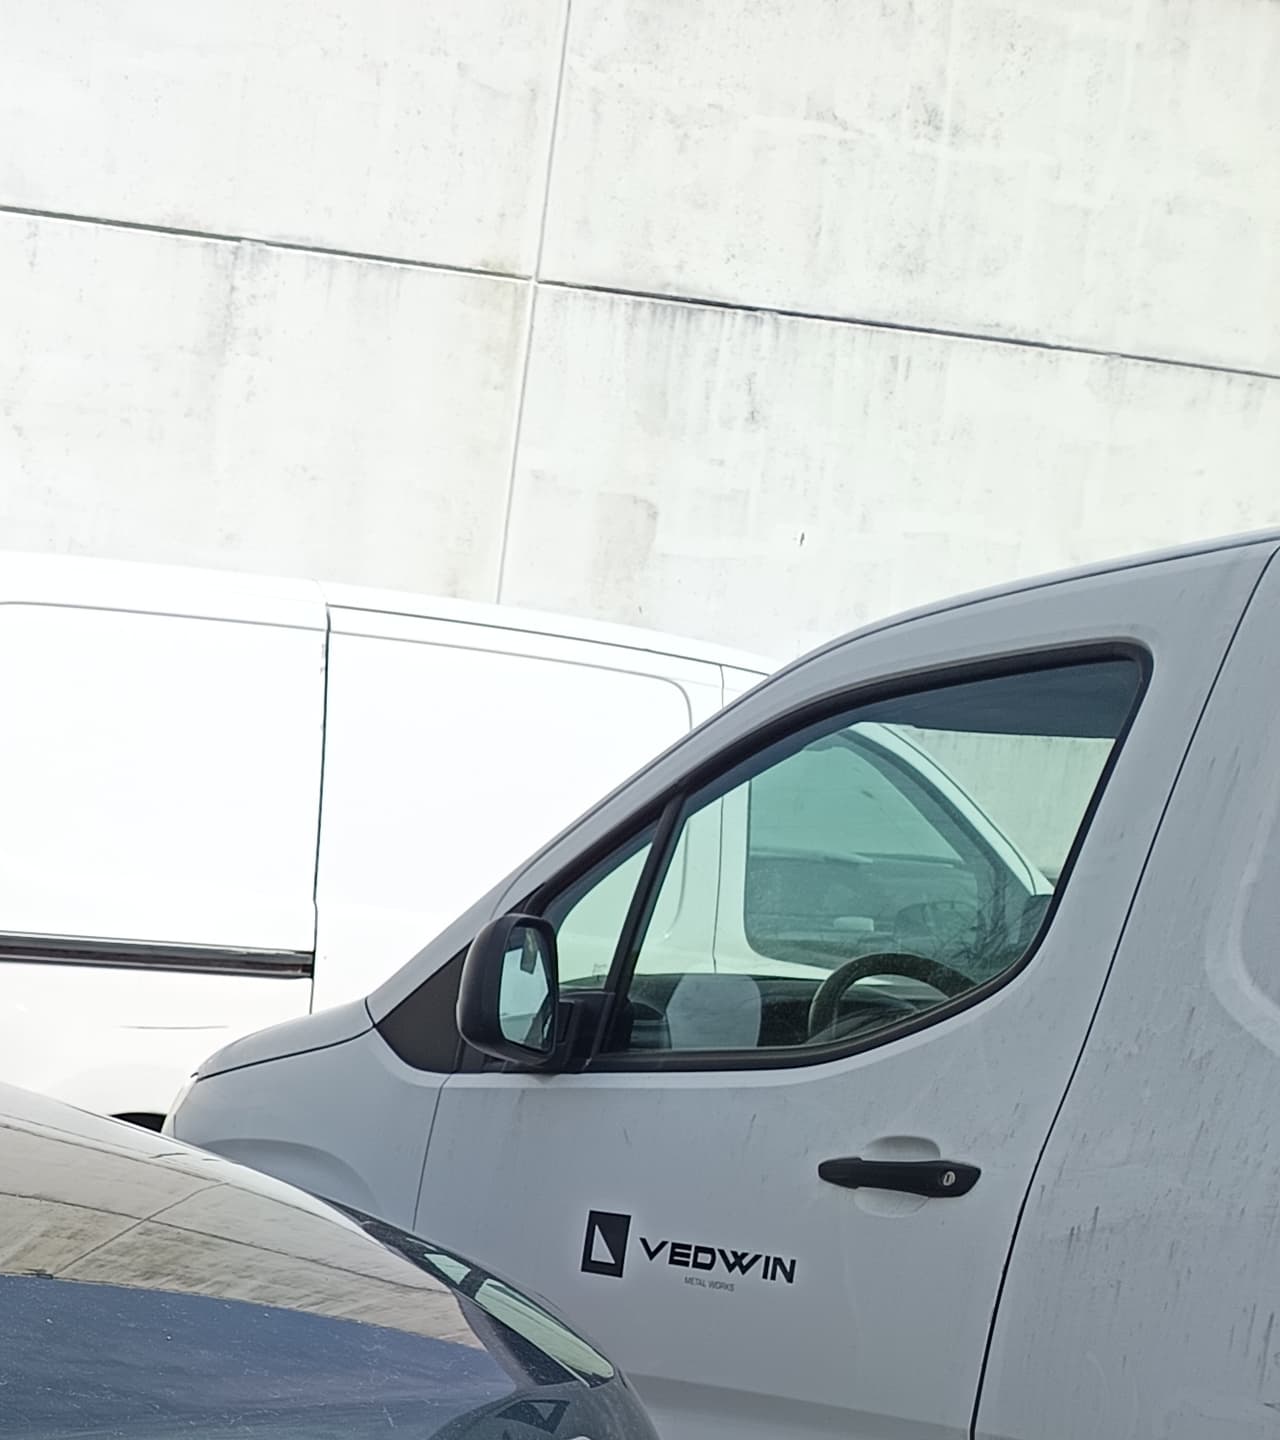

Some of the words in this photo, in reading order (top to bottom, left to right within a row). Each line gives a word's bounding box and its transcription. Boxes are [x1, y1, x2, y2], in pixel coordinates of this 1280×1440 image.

[639, 1237, 798, 1284] VEDWIN
[683, 1276, 707, 1288] METAL
[708, 1280, 735, 1292] WORKS
